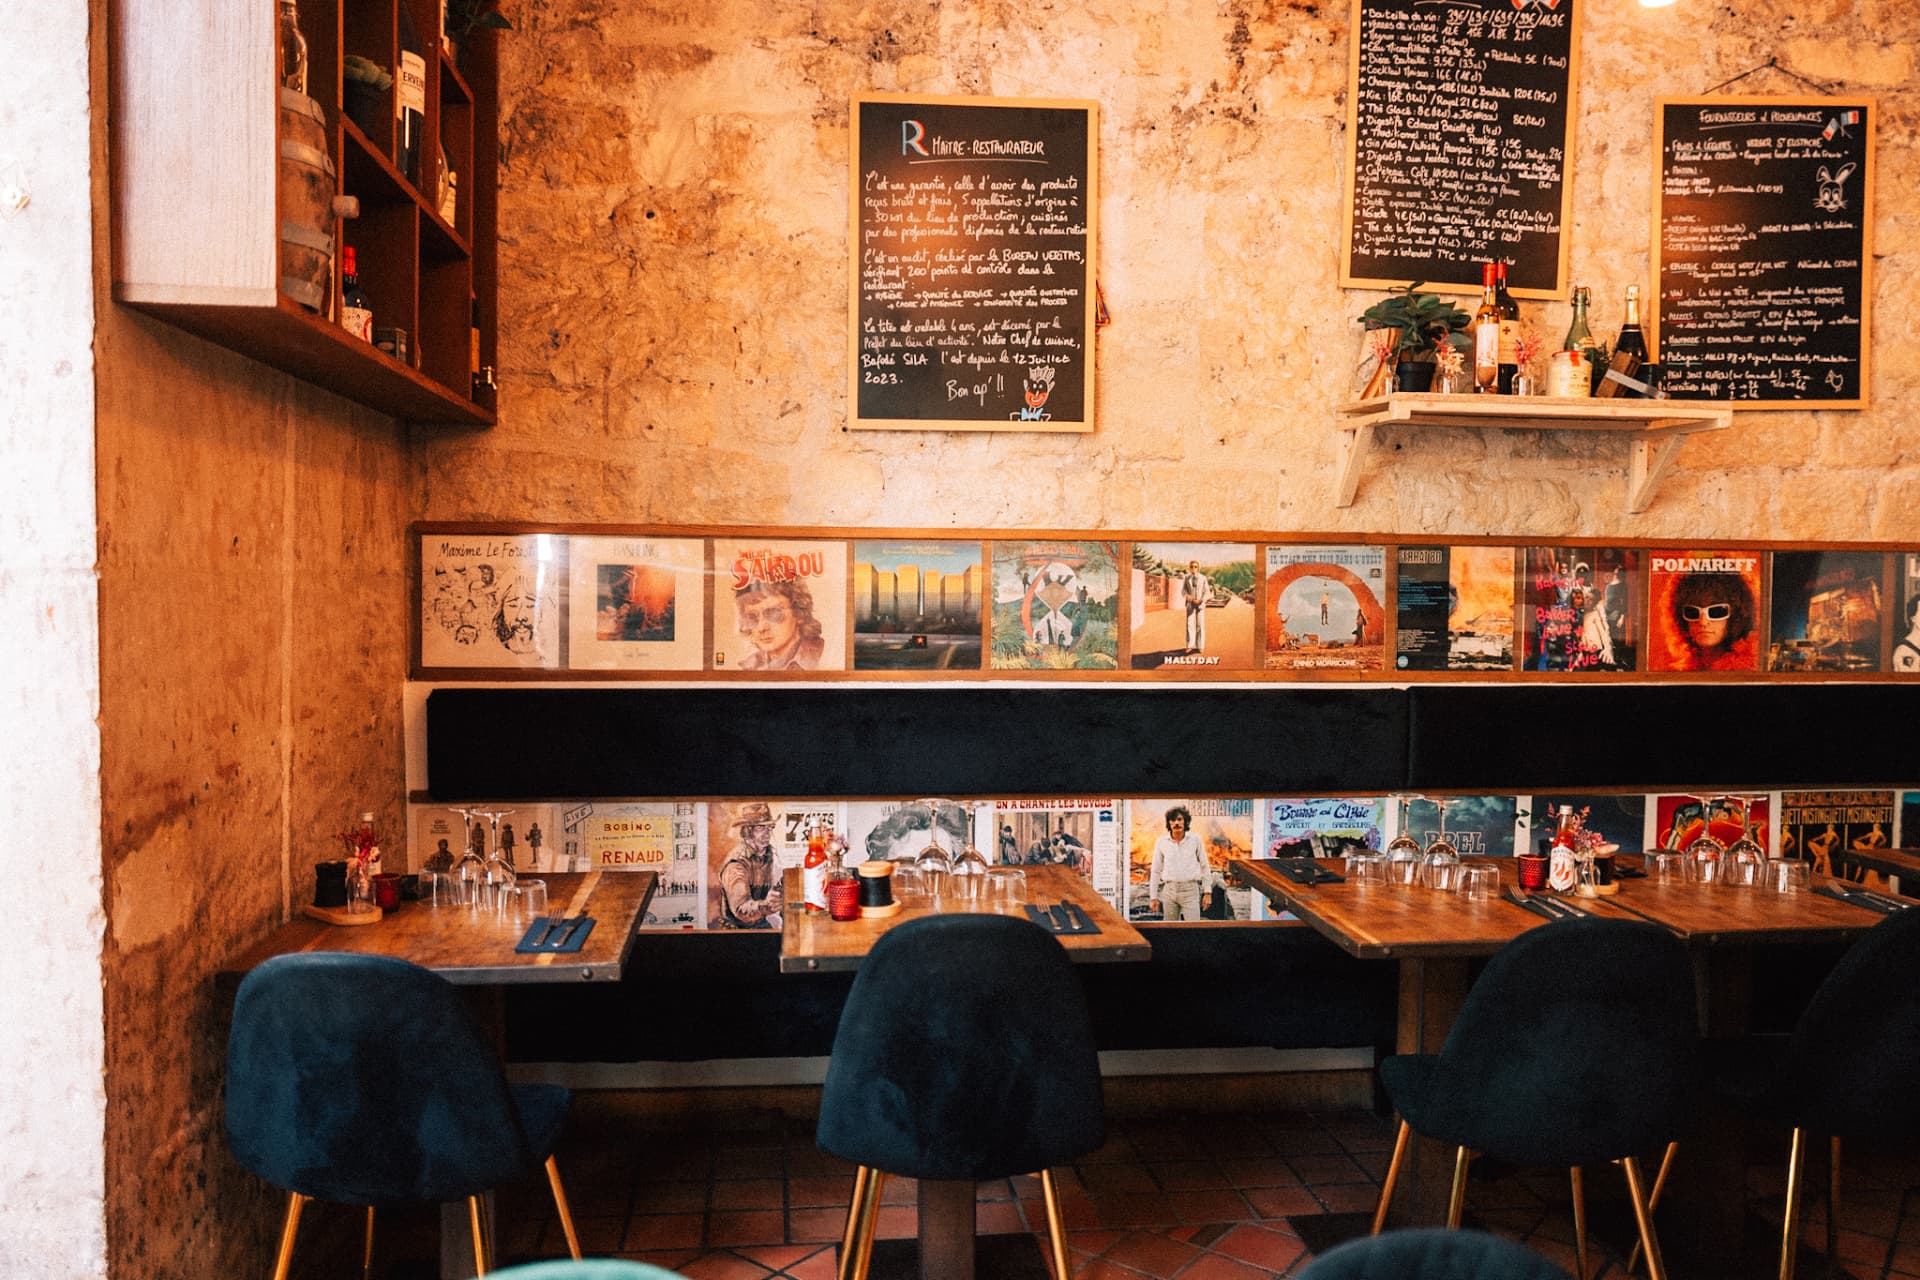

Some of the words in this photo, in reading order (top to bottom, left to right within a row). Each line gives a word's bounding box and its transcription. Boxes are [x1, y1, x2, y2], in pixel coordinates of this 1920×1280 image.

[907, 265, 927, 277] 200
[946, 379, 968, 401] Bon
[440, 542, 481, 558] Maxime
[487, 542, 499, 558] Le
[731, 551, 825, 591] SARDOU
[1652, 558, 1757, 572] POLNAREFF
[1164, 656, 1220, 665] HALLYDAY
[996, 800, 1008, 809] ON
[1058, 799, 1074, 808] LES
[1424, 831, 1486, 855] BREL
[602, 850, 664, 864] RENAUD
